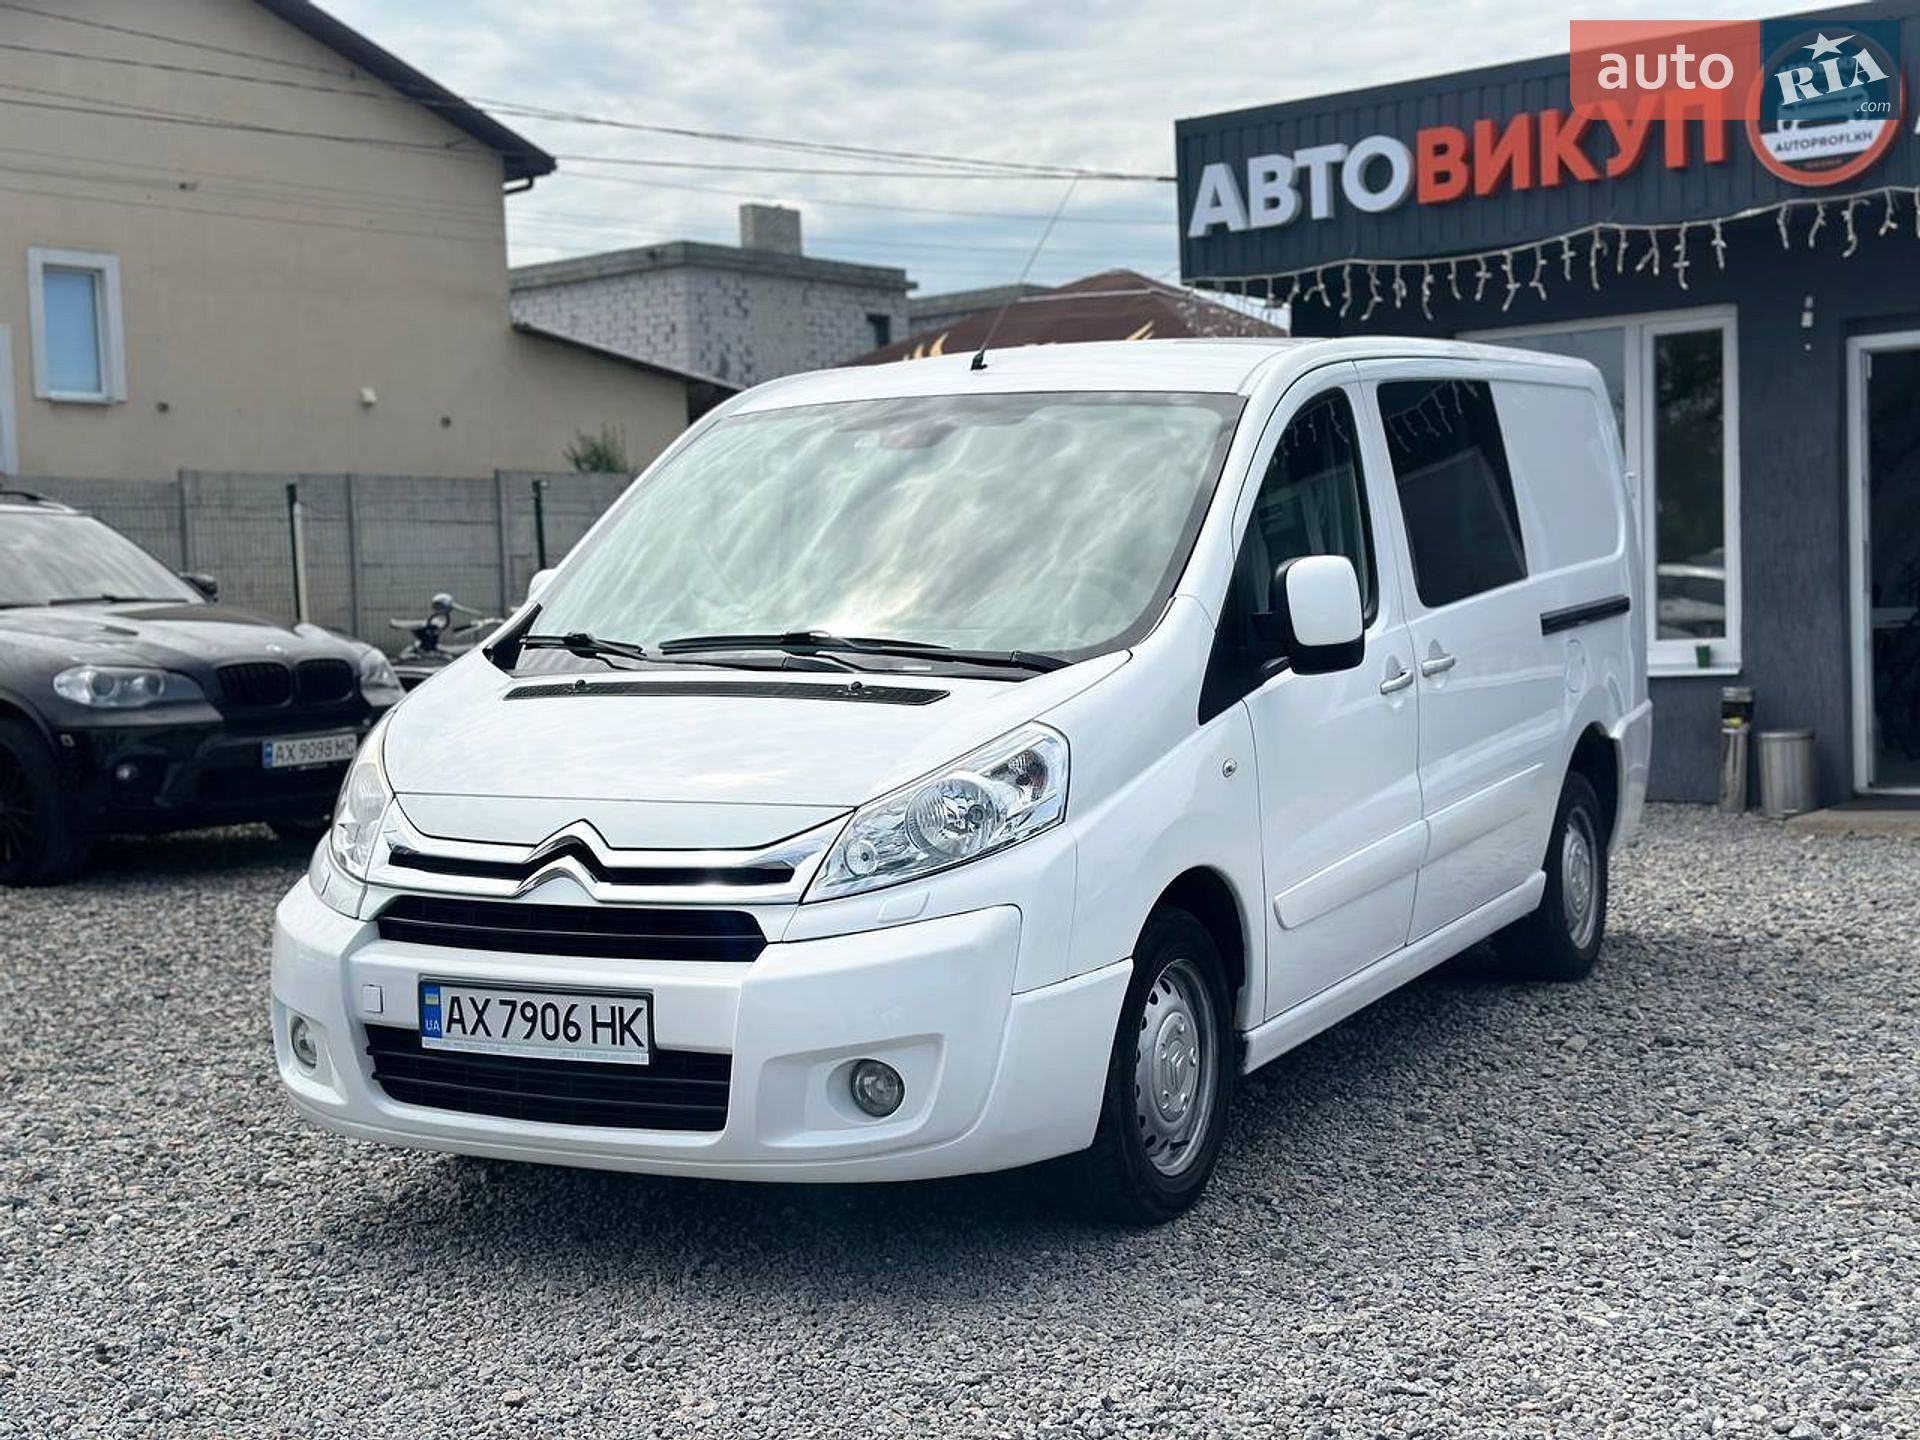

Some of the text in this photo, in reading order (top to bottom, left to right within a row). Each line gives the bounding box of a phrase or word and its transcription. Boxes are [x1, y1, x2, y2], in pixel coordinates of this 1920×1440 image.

[425, 1020, 440, 1032] UA
[446, 996, 645, 1047] AX 7906 HK
